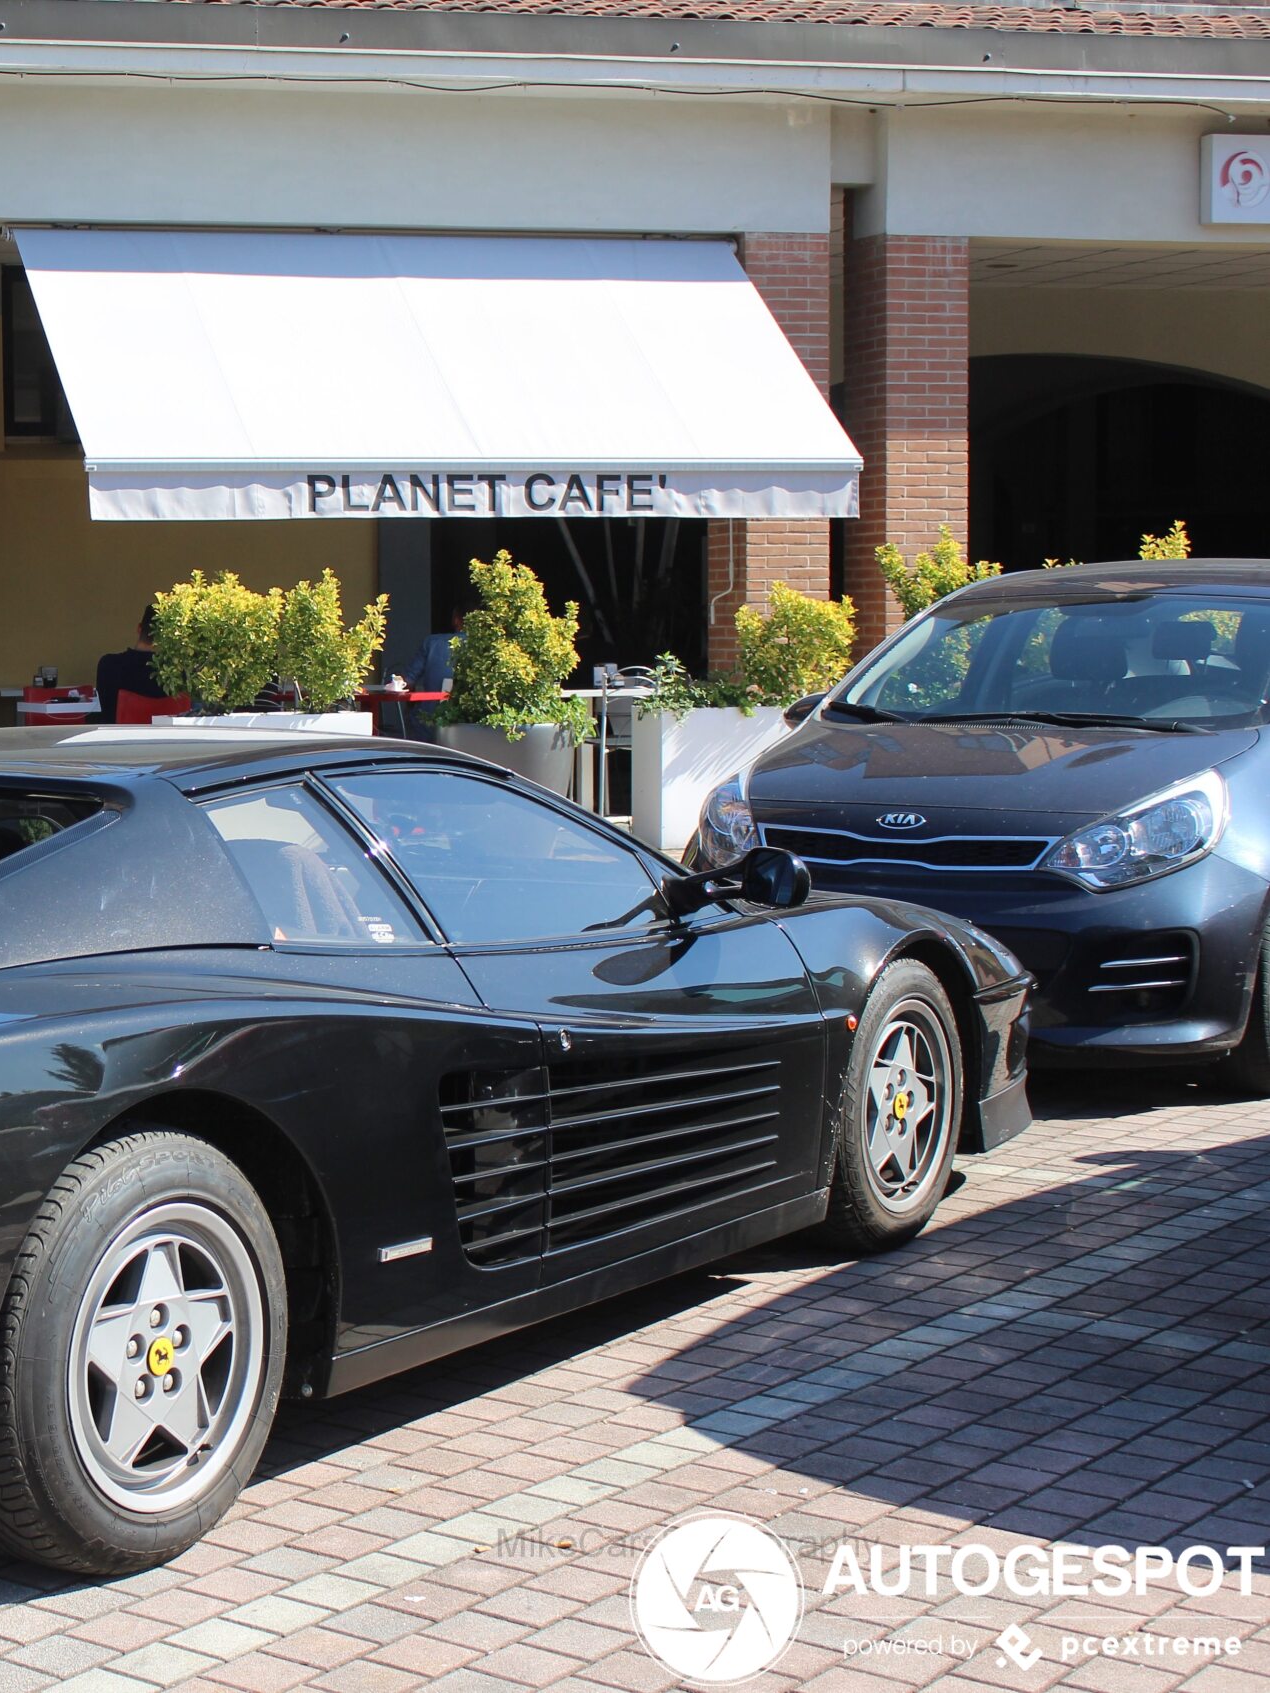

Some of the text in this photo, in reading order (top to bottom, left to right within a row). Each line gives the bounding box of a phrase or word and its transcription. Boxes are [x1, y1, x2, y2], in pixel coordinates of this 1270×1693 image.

[306, 473, 666, 512] PLANET CAFE'
[884, 813, 916, 825] KIA
